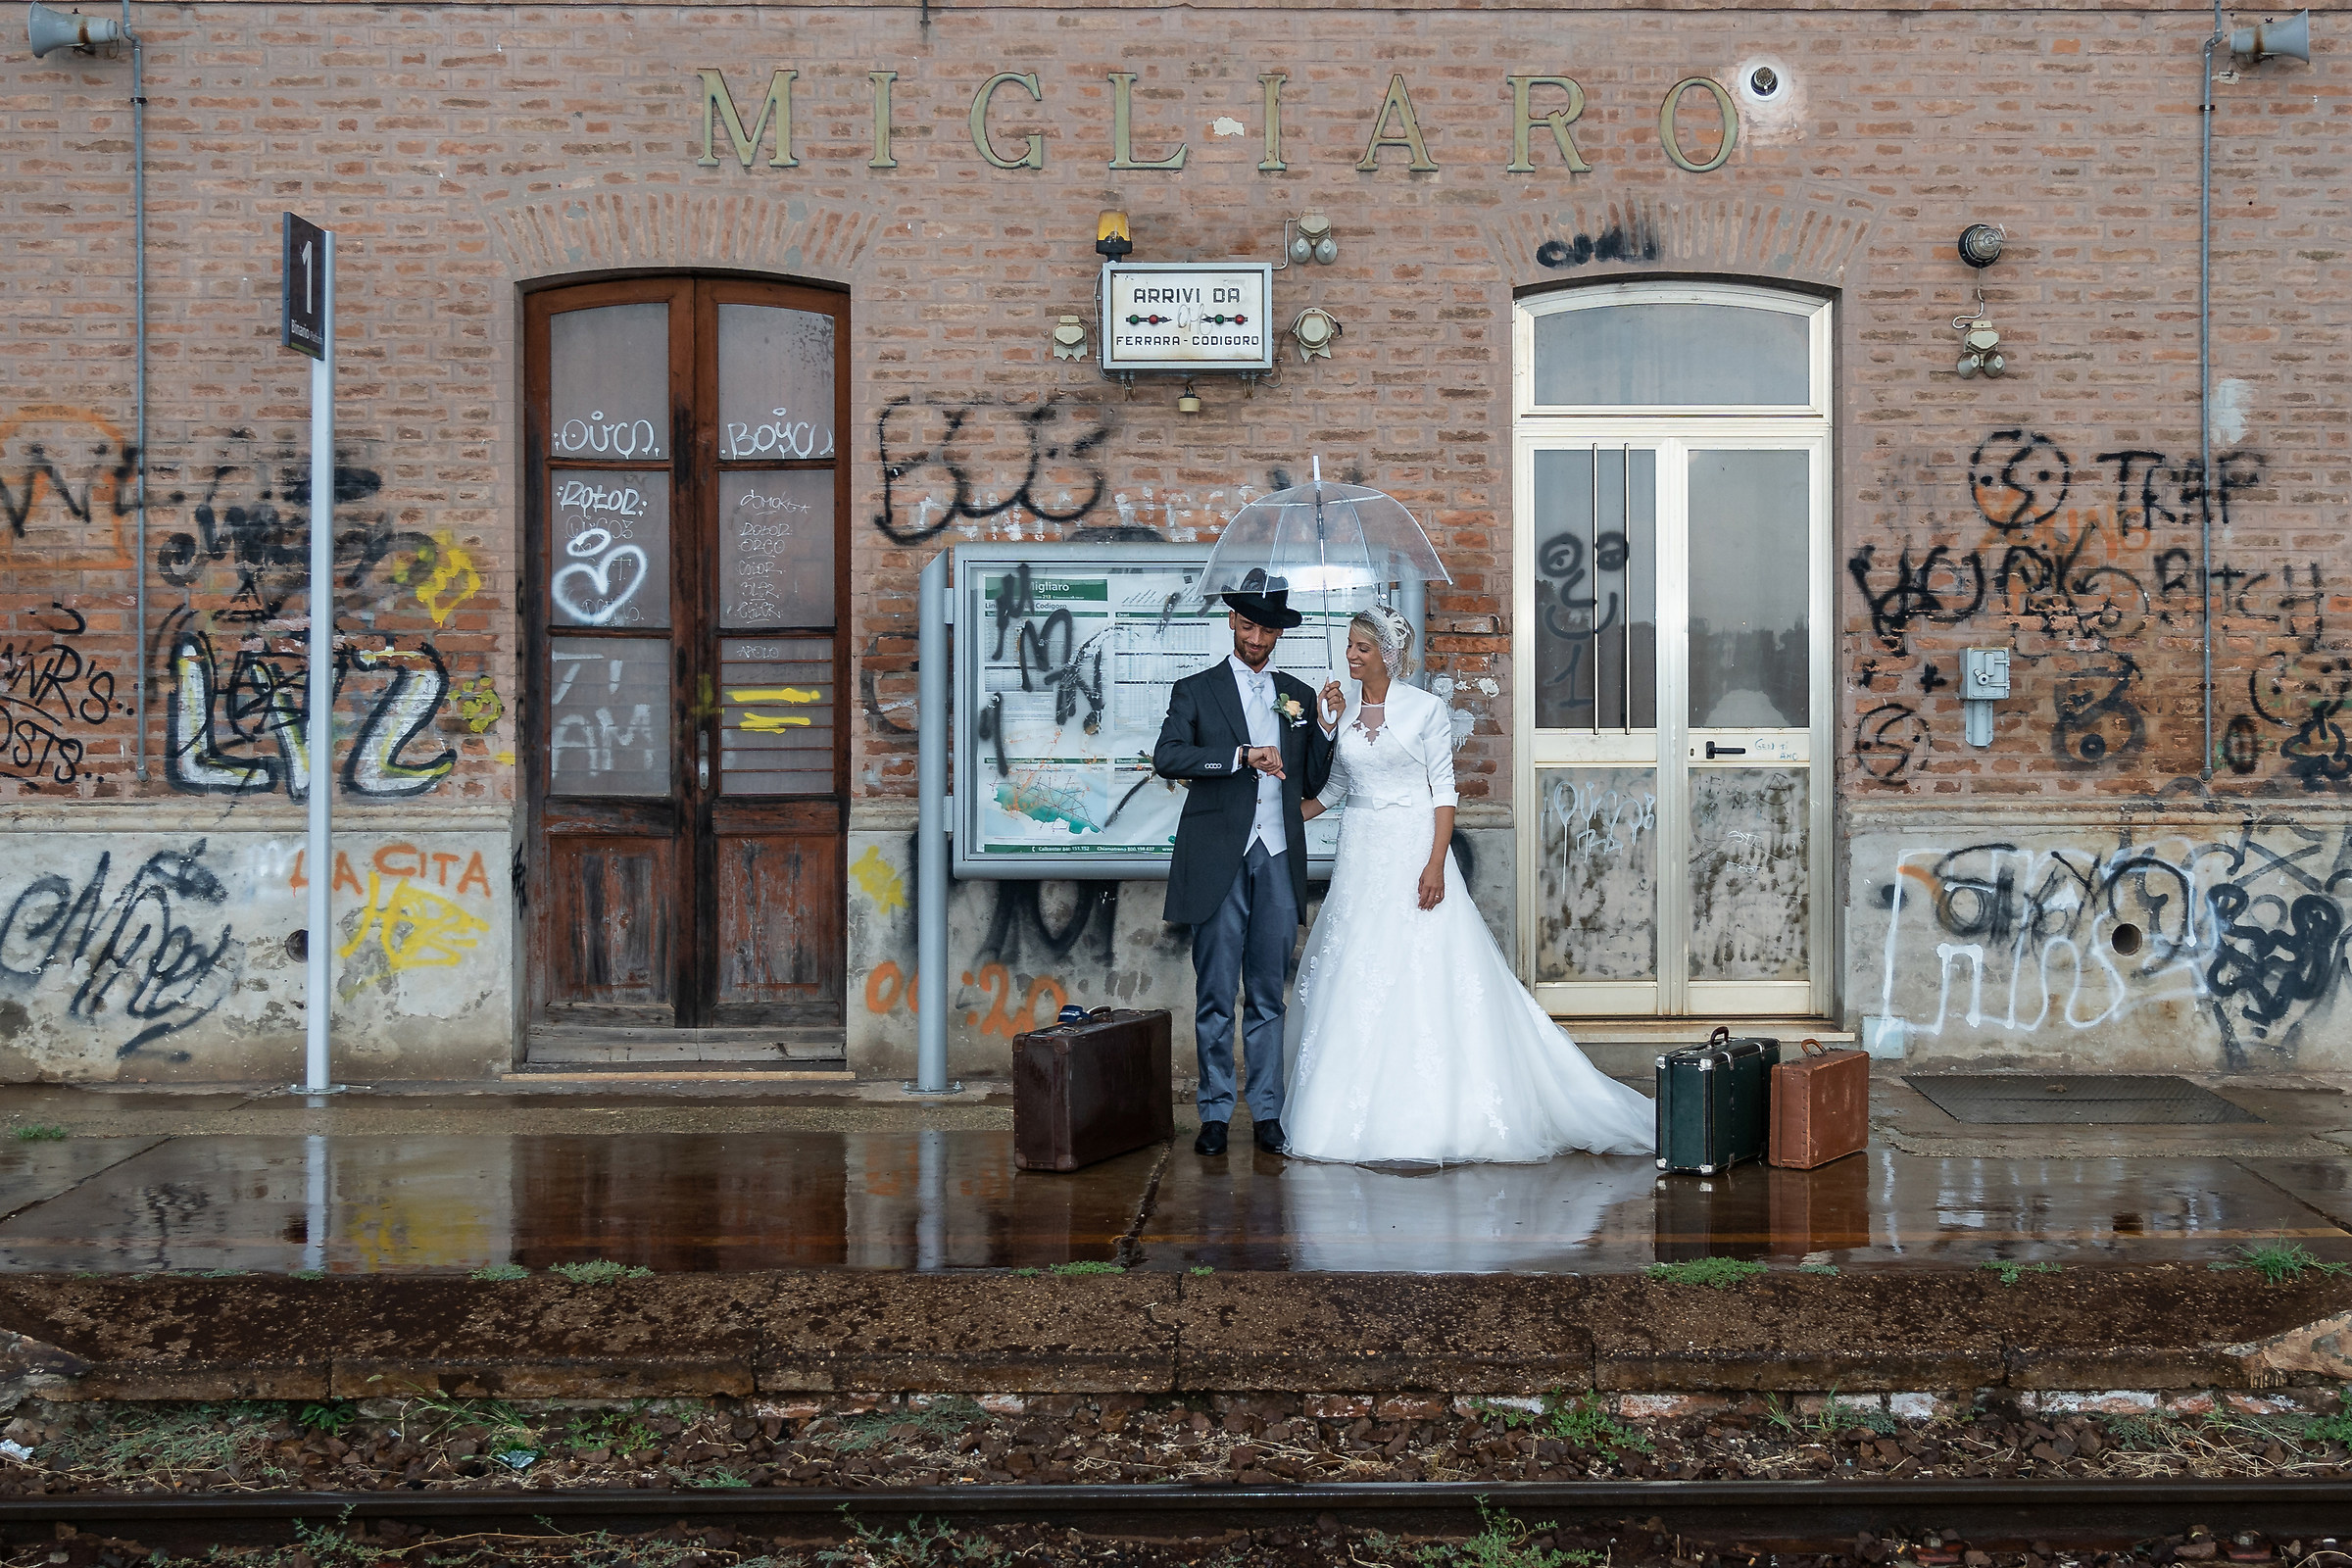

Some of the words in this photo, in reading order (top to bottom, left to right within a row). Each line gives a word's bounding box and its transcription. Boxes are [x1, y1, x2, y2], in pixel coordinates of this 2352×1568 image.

[698, 68, 1740, 173] MIGLIARO
[302, 240, 313, 315] 1
[1133, 288, 1201, 304] ARRIVI
[1212, 288, 1241, 304] DA
[1115, 336, 1181, 346] FERRARA
[1192, 335, 1259, 346] CODIGORO
[373, 843, 492, 898] CITA
